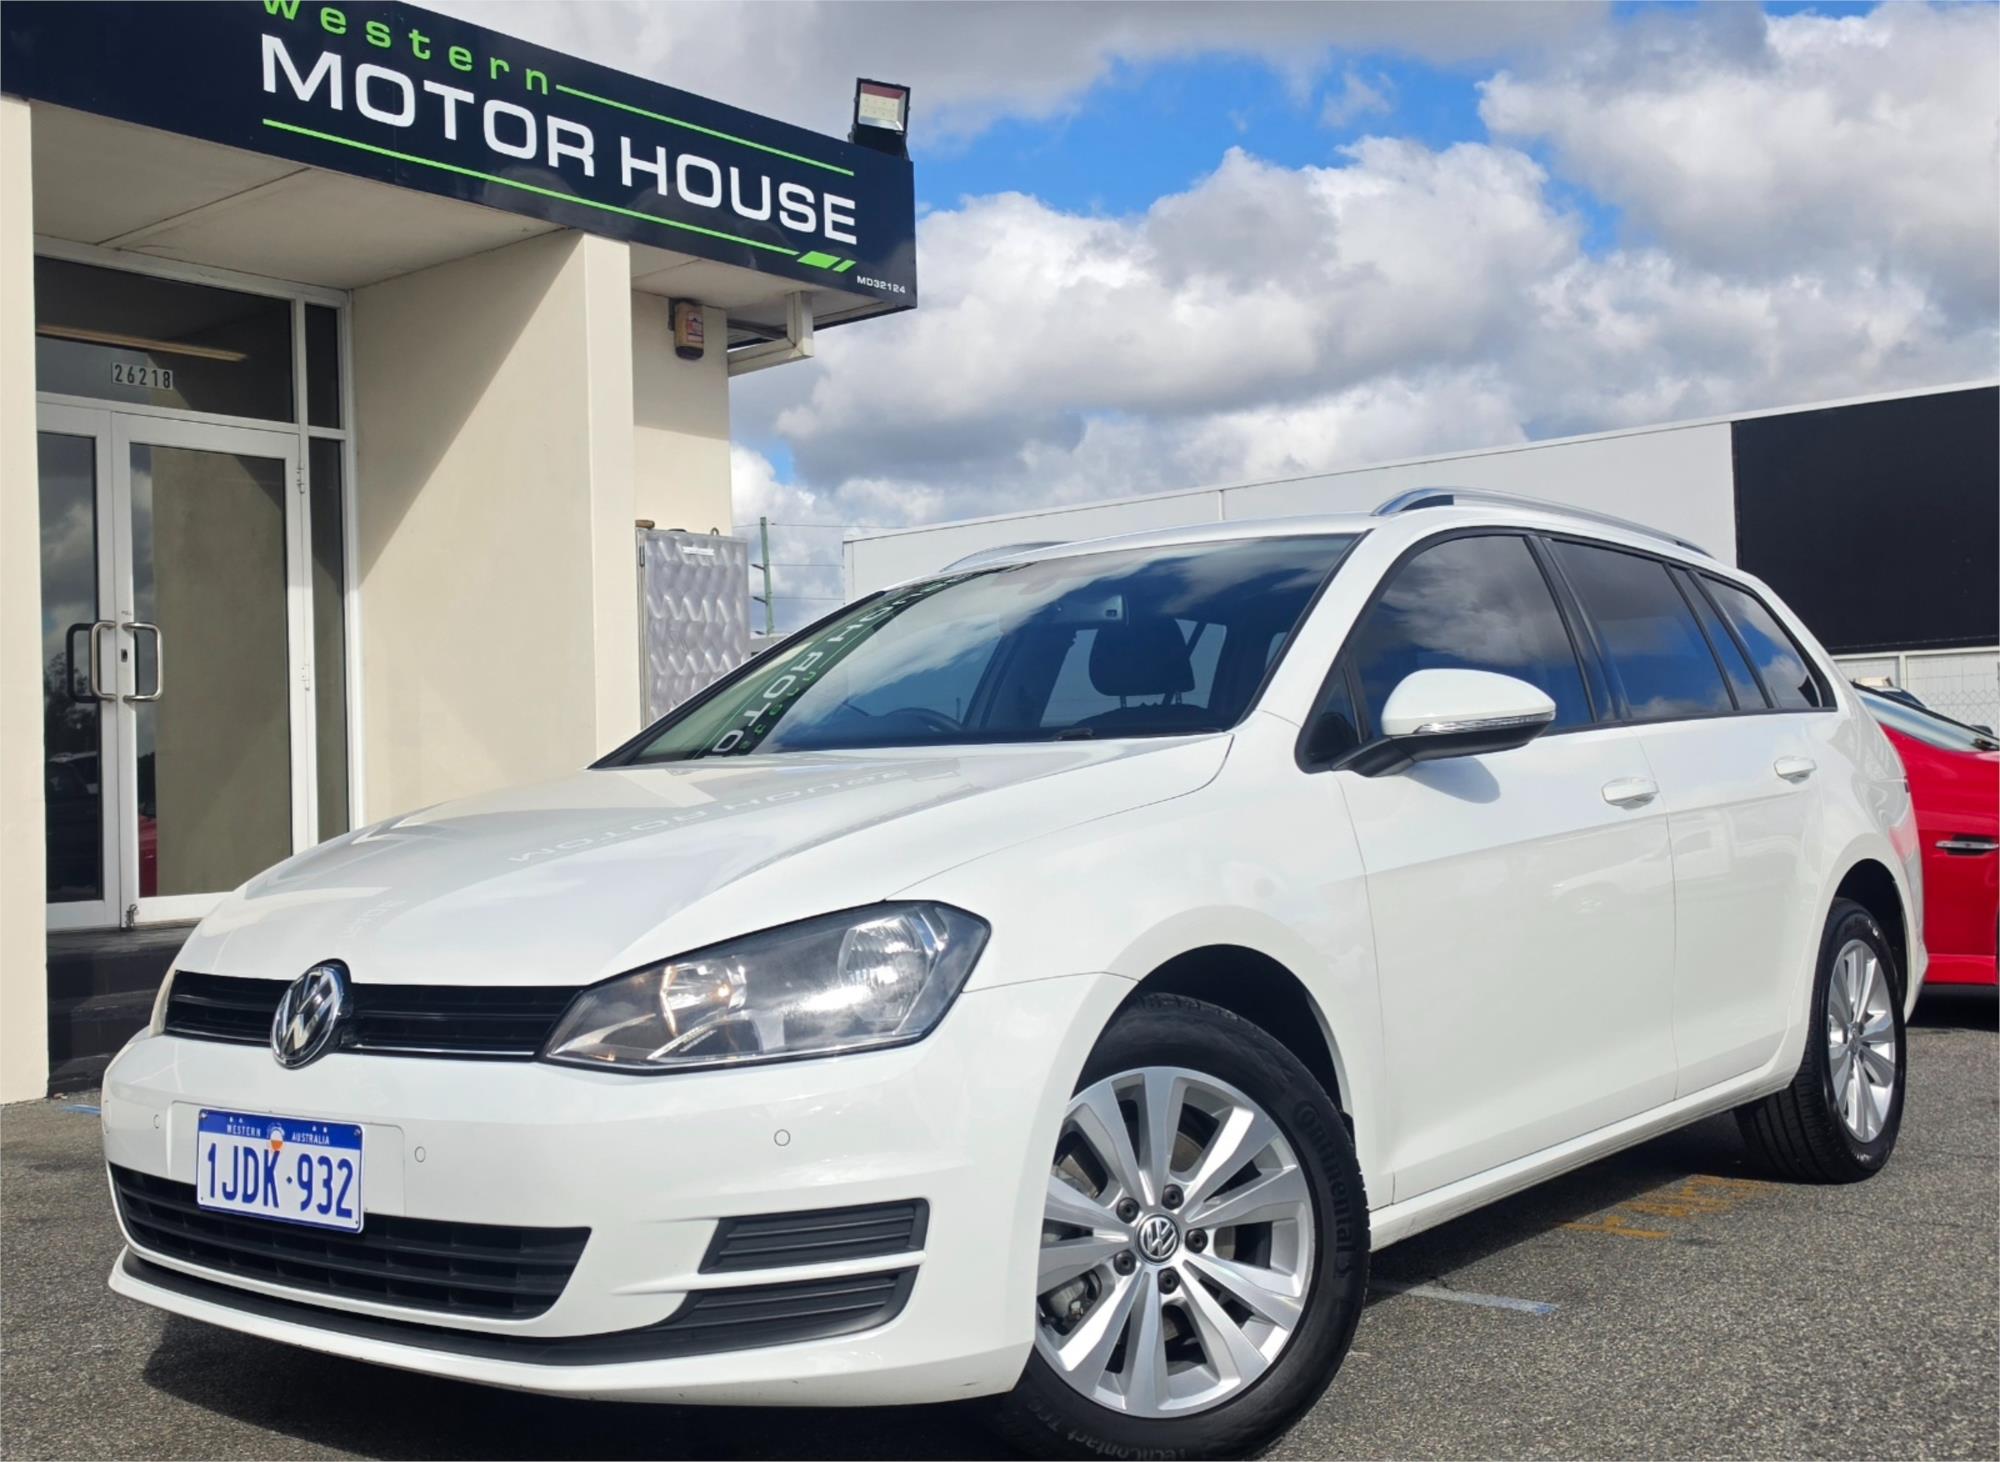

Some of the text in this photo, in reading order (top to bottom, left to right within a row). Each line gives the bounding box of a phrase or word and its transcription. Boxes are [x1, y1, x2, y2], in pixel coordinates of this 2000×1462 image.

[263, 0, 548, 95] western
[262, 33, 858, 245] MOTOR HOUSE
[856, 275, 906, 294] MD32124
[114, 363, 171, 389] 26218
[226, 1123, 330, 1146] WESTERN AUSTRALIA
